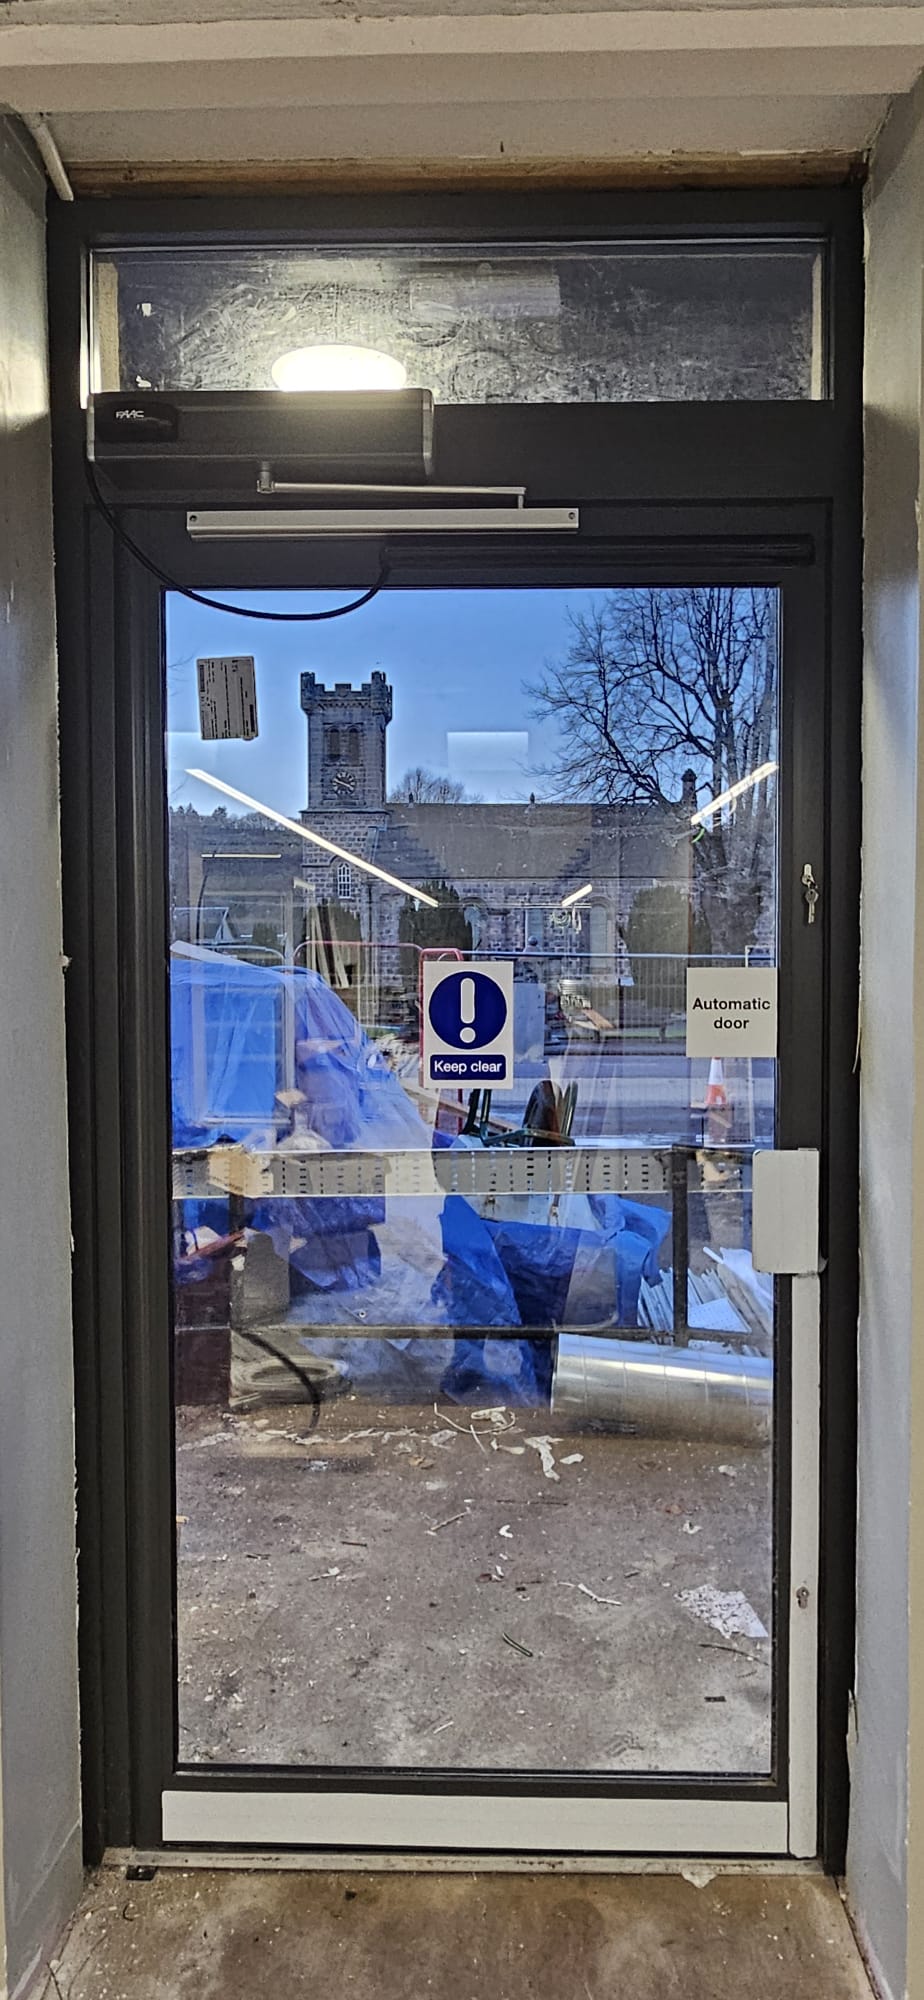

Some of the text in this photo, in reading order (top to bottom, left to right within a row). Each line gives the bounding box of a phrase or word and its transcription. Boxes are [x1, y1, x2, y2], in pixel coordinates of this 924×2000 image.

[692, 997, 771, 1010] Automatic
[713, 1016, 750, 1029] door
[434, 1060, 503, 1075] Keep clear
